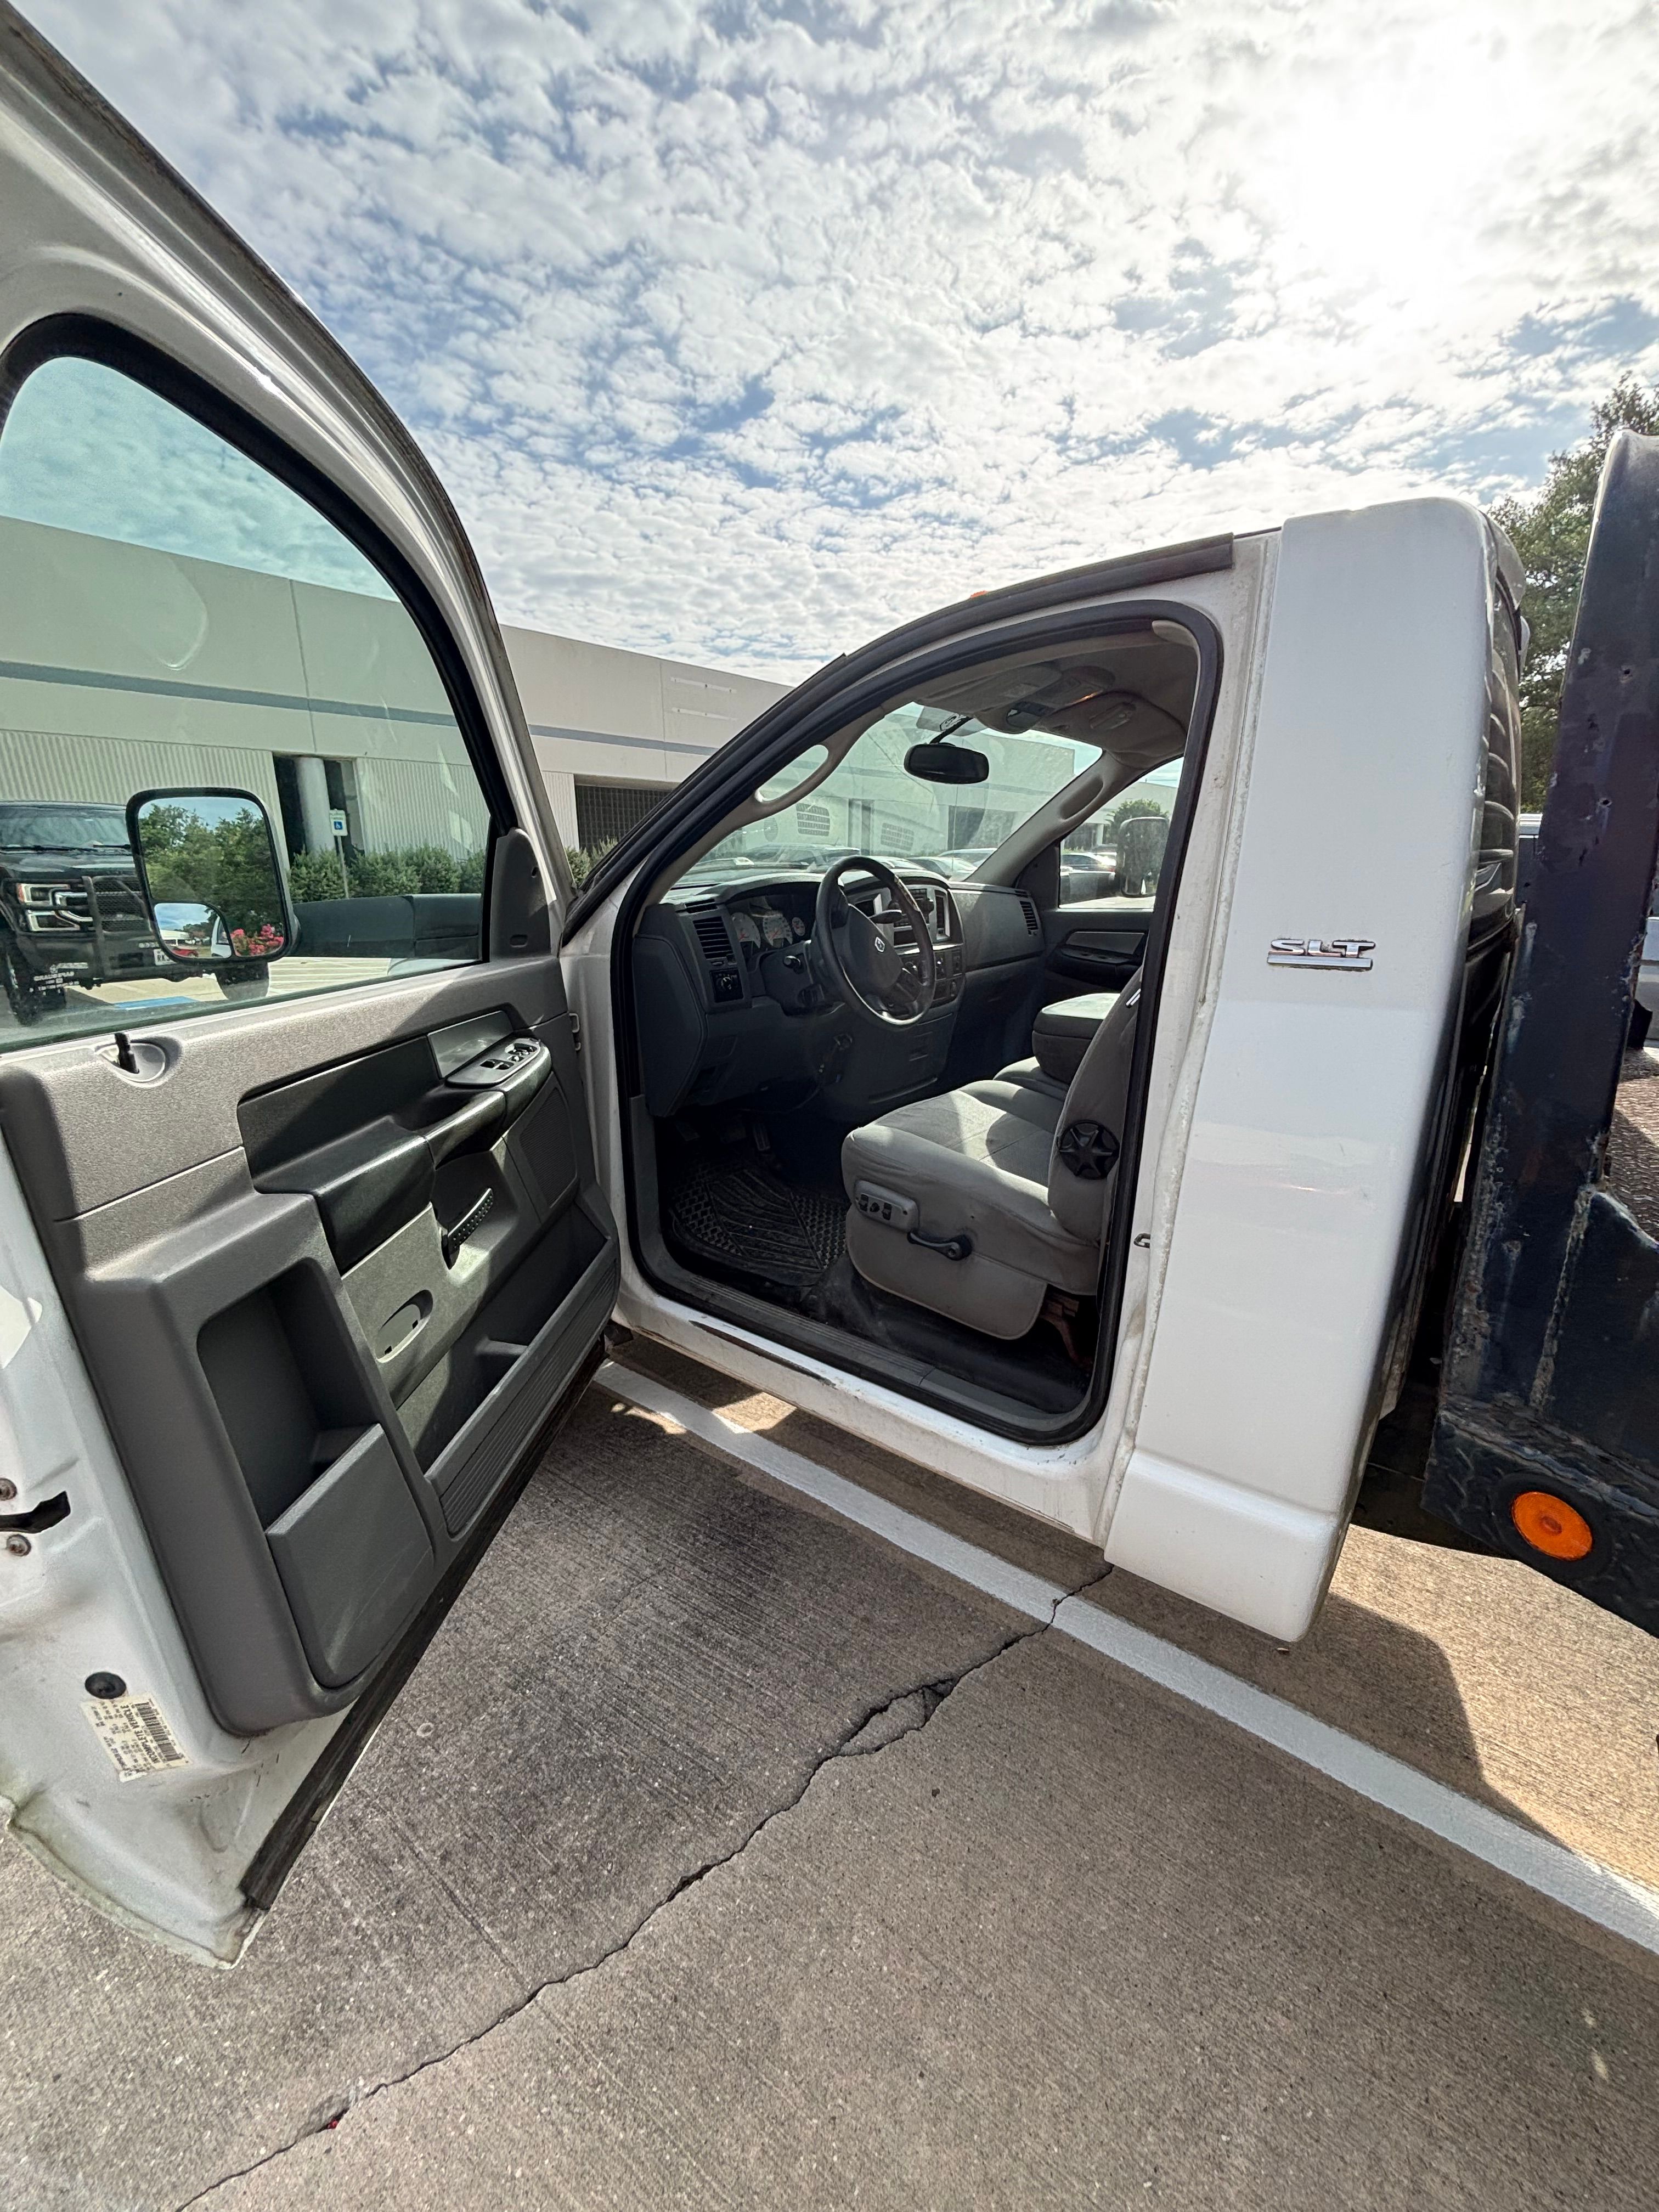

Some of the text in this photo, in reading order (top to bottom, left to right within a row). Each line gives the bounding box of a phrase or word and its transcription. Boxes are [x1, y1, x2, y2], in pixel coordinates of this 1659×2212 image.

[1270, 938, 1376, 958] SLT
[120, 1705, 140, 1729] VEHICLE
[134, 1730, 161, 1764] INCOMPLETE
